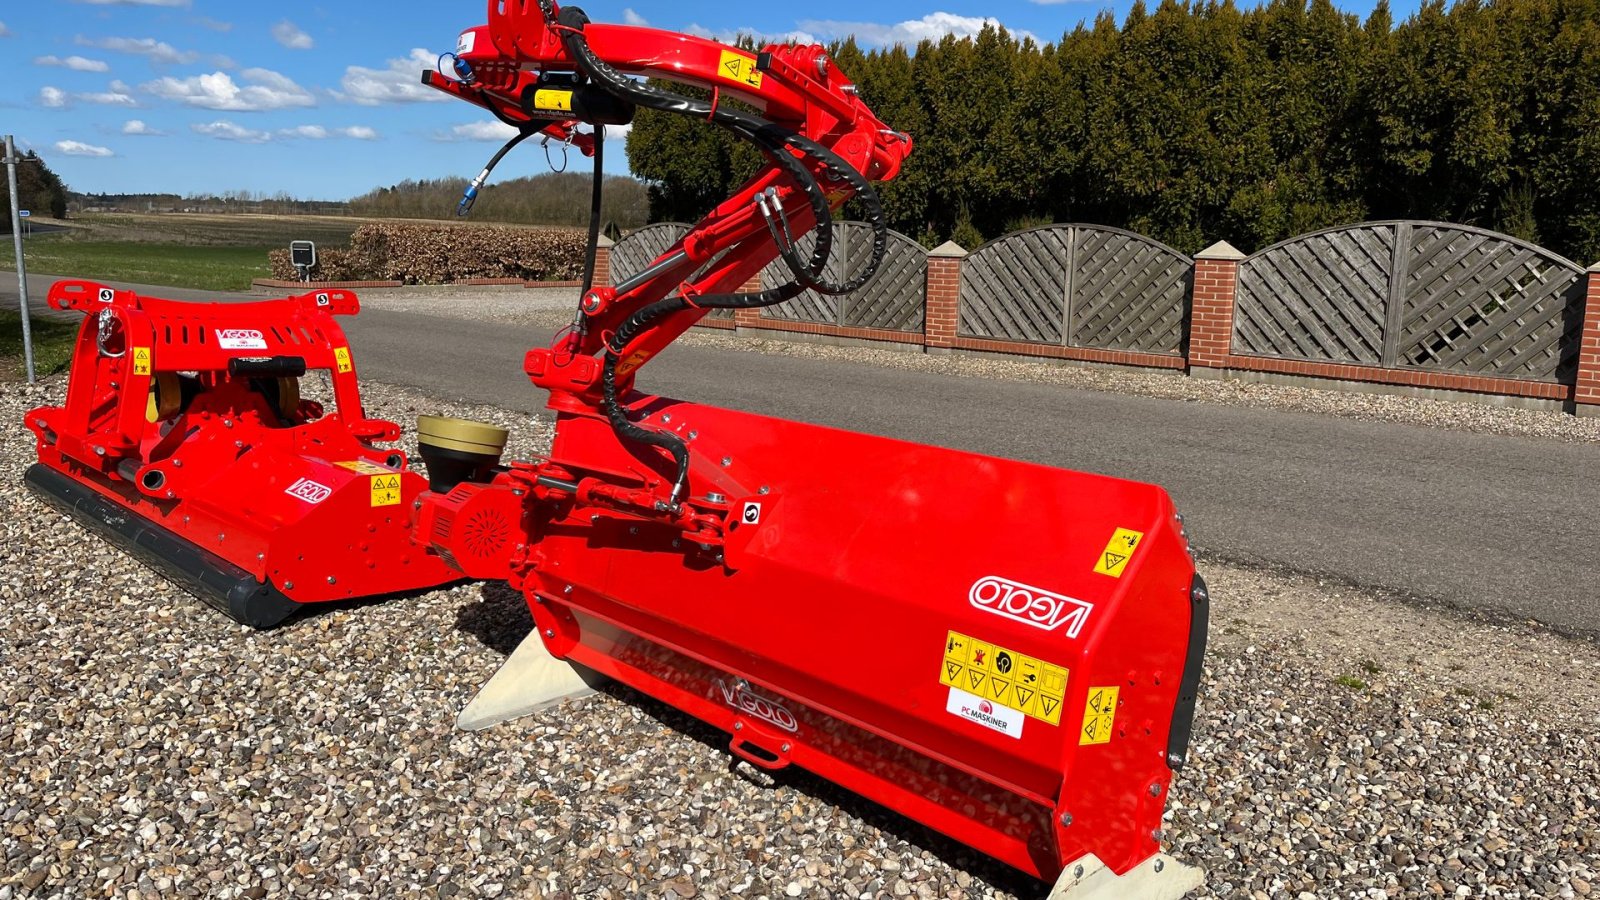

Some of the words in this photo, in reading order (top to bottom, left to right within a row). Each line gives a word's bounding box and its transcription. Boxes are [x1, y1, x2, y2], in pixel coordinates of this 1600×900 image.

[284, 476, 332, 504] VIGOLO
[968, 575, 1094, 639] VIGOLO
[719, 679, 798, 732] VIGOLO
[961, 706, 970, 715] PC
[970, 710, 1008, 729] MASKINER
